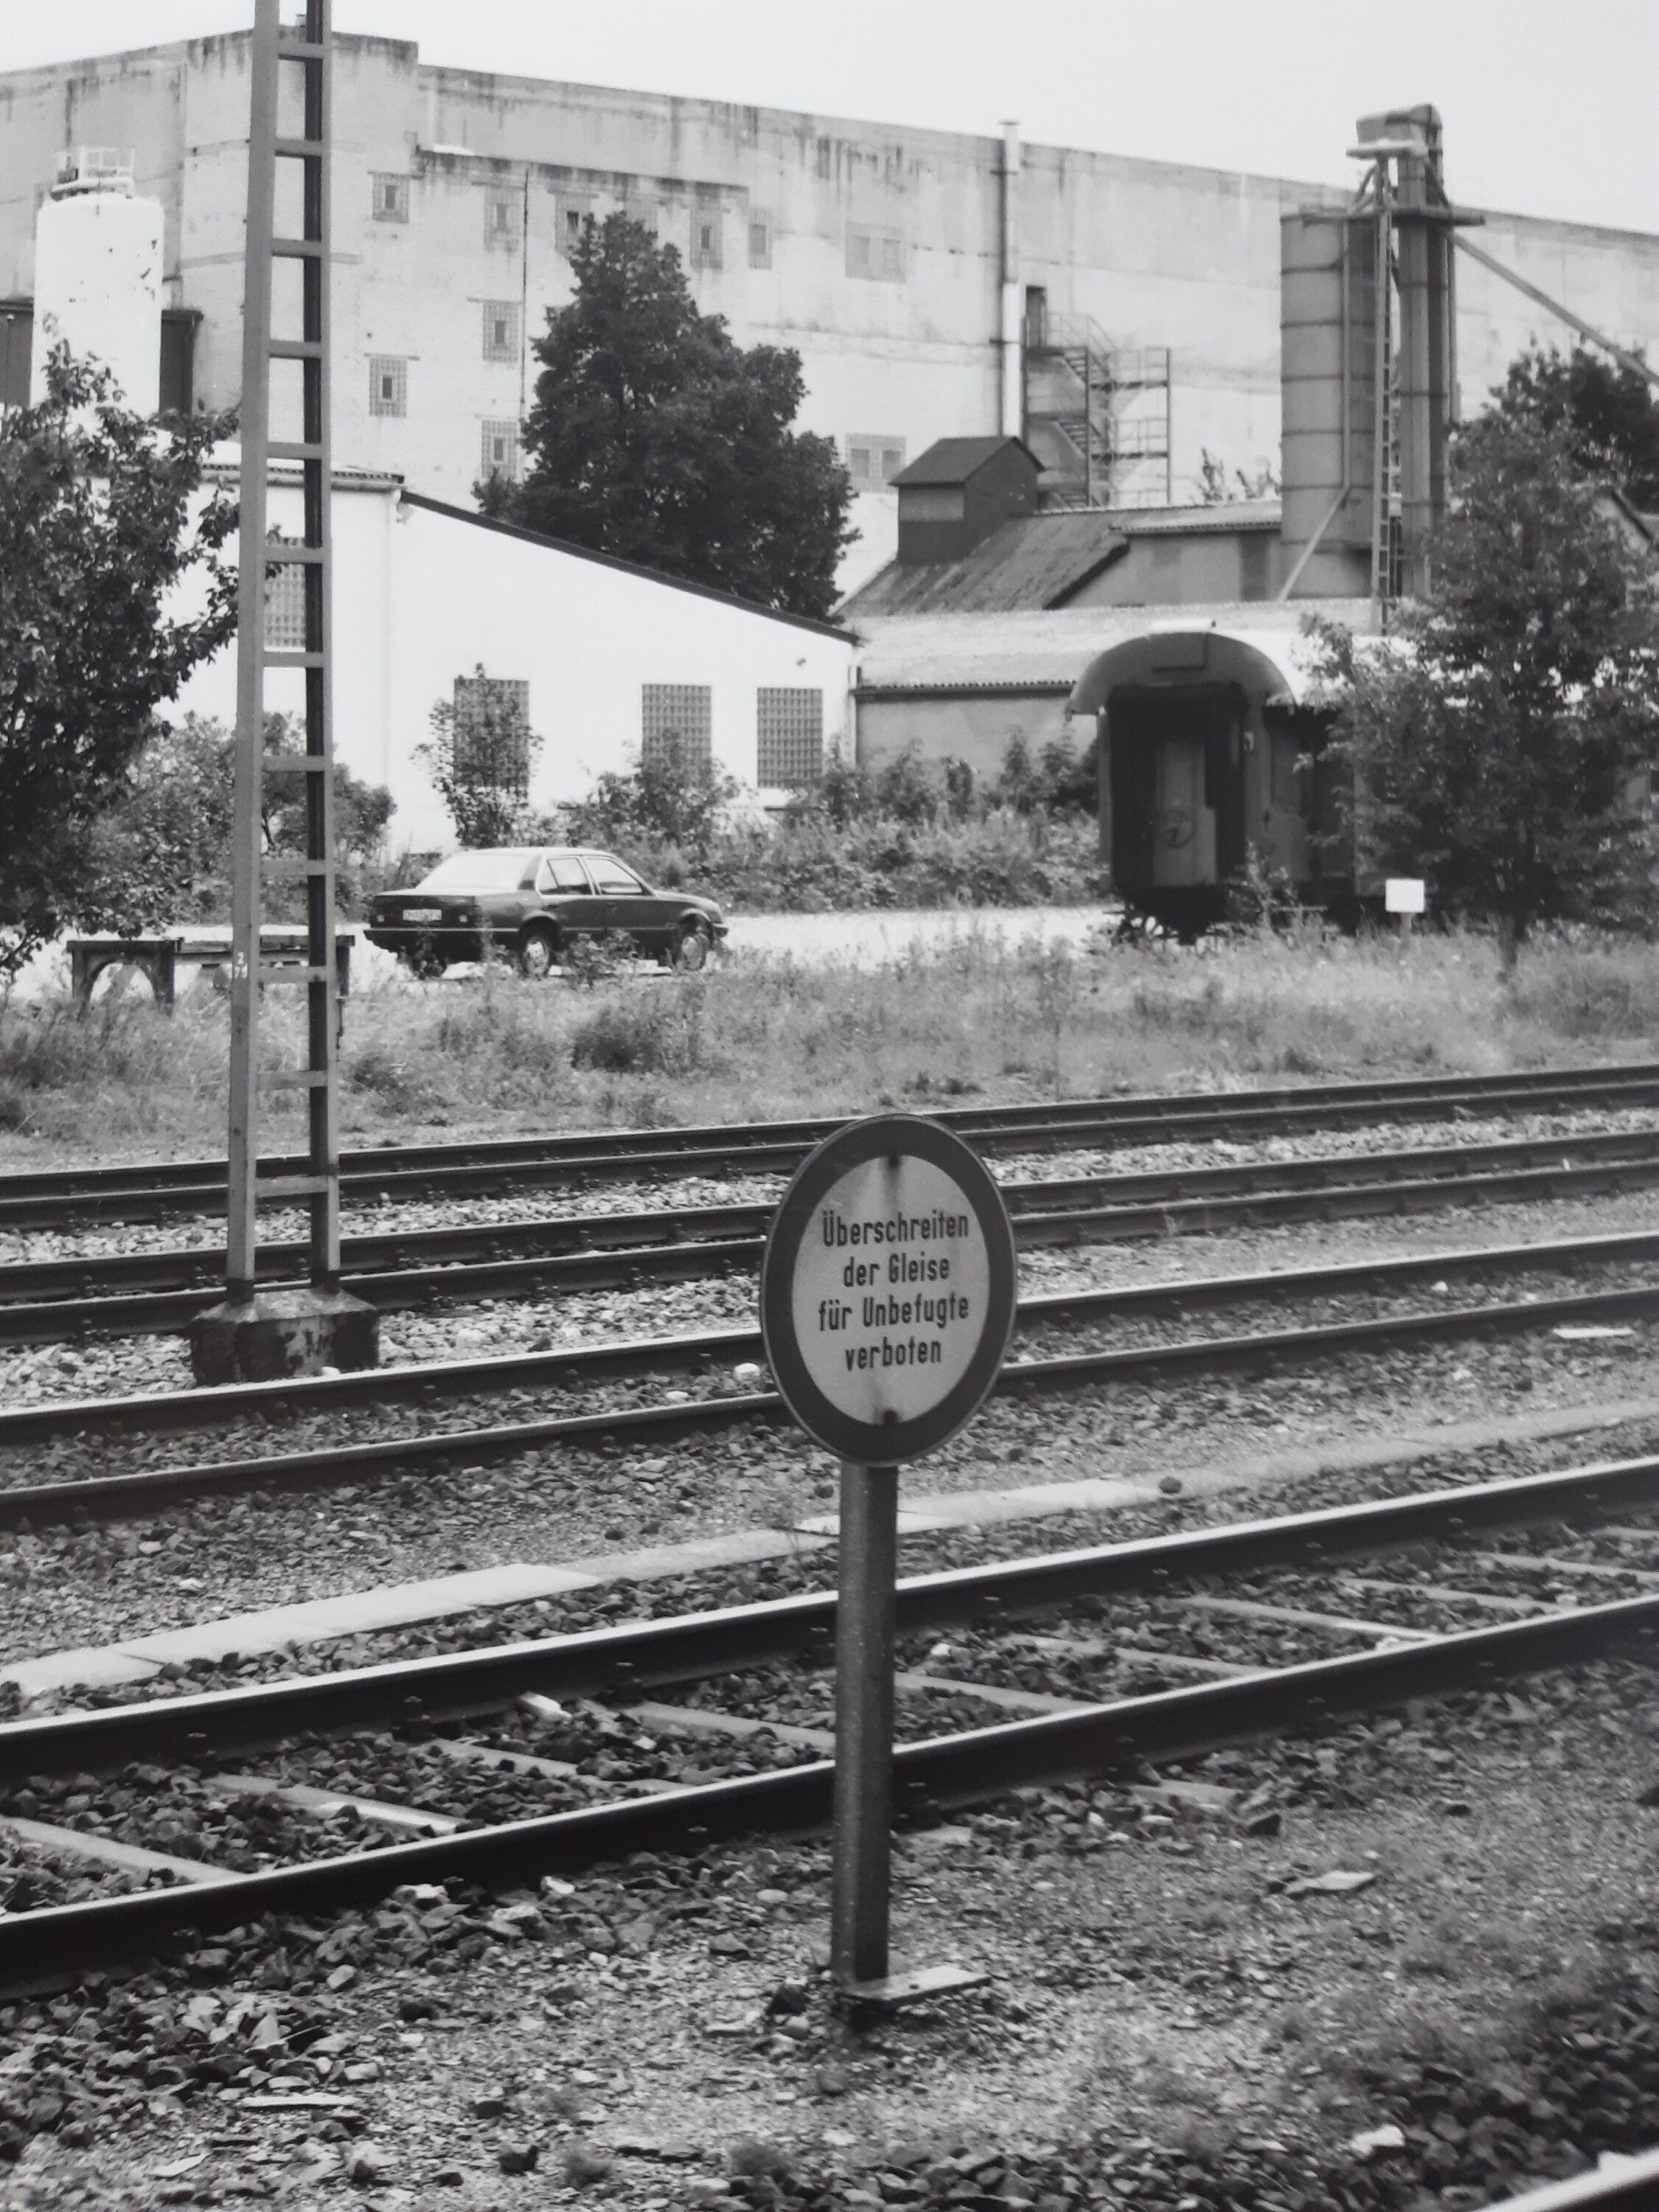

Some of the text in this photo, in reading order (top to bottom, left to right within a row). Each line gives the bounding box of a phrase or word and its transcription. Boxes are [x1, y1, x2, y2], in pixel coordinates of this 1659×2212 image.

[823, 1209, 968, 1247] Überschreiten
[844, 1251, 950, 1287] der Gleise
[818, 1293, 970, 1331] für Unbefugte
[845, 1336, 941, 1371] verboten
